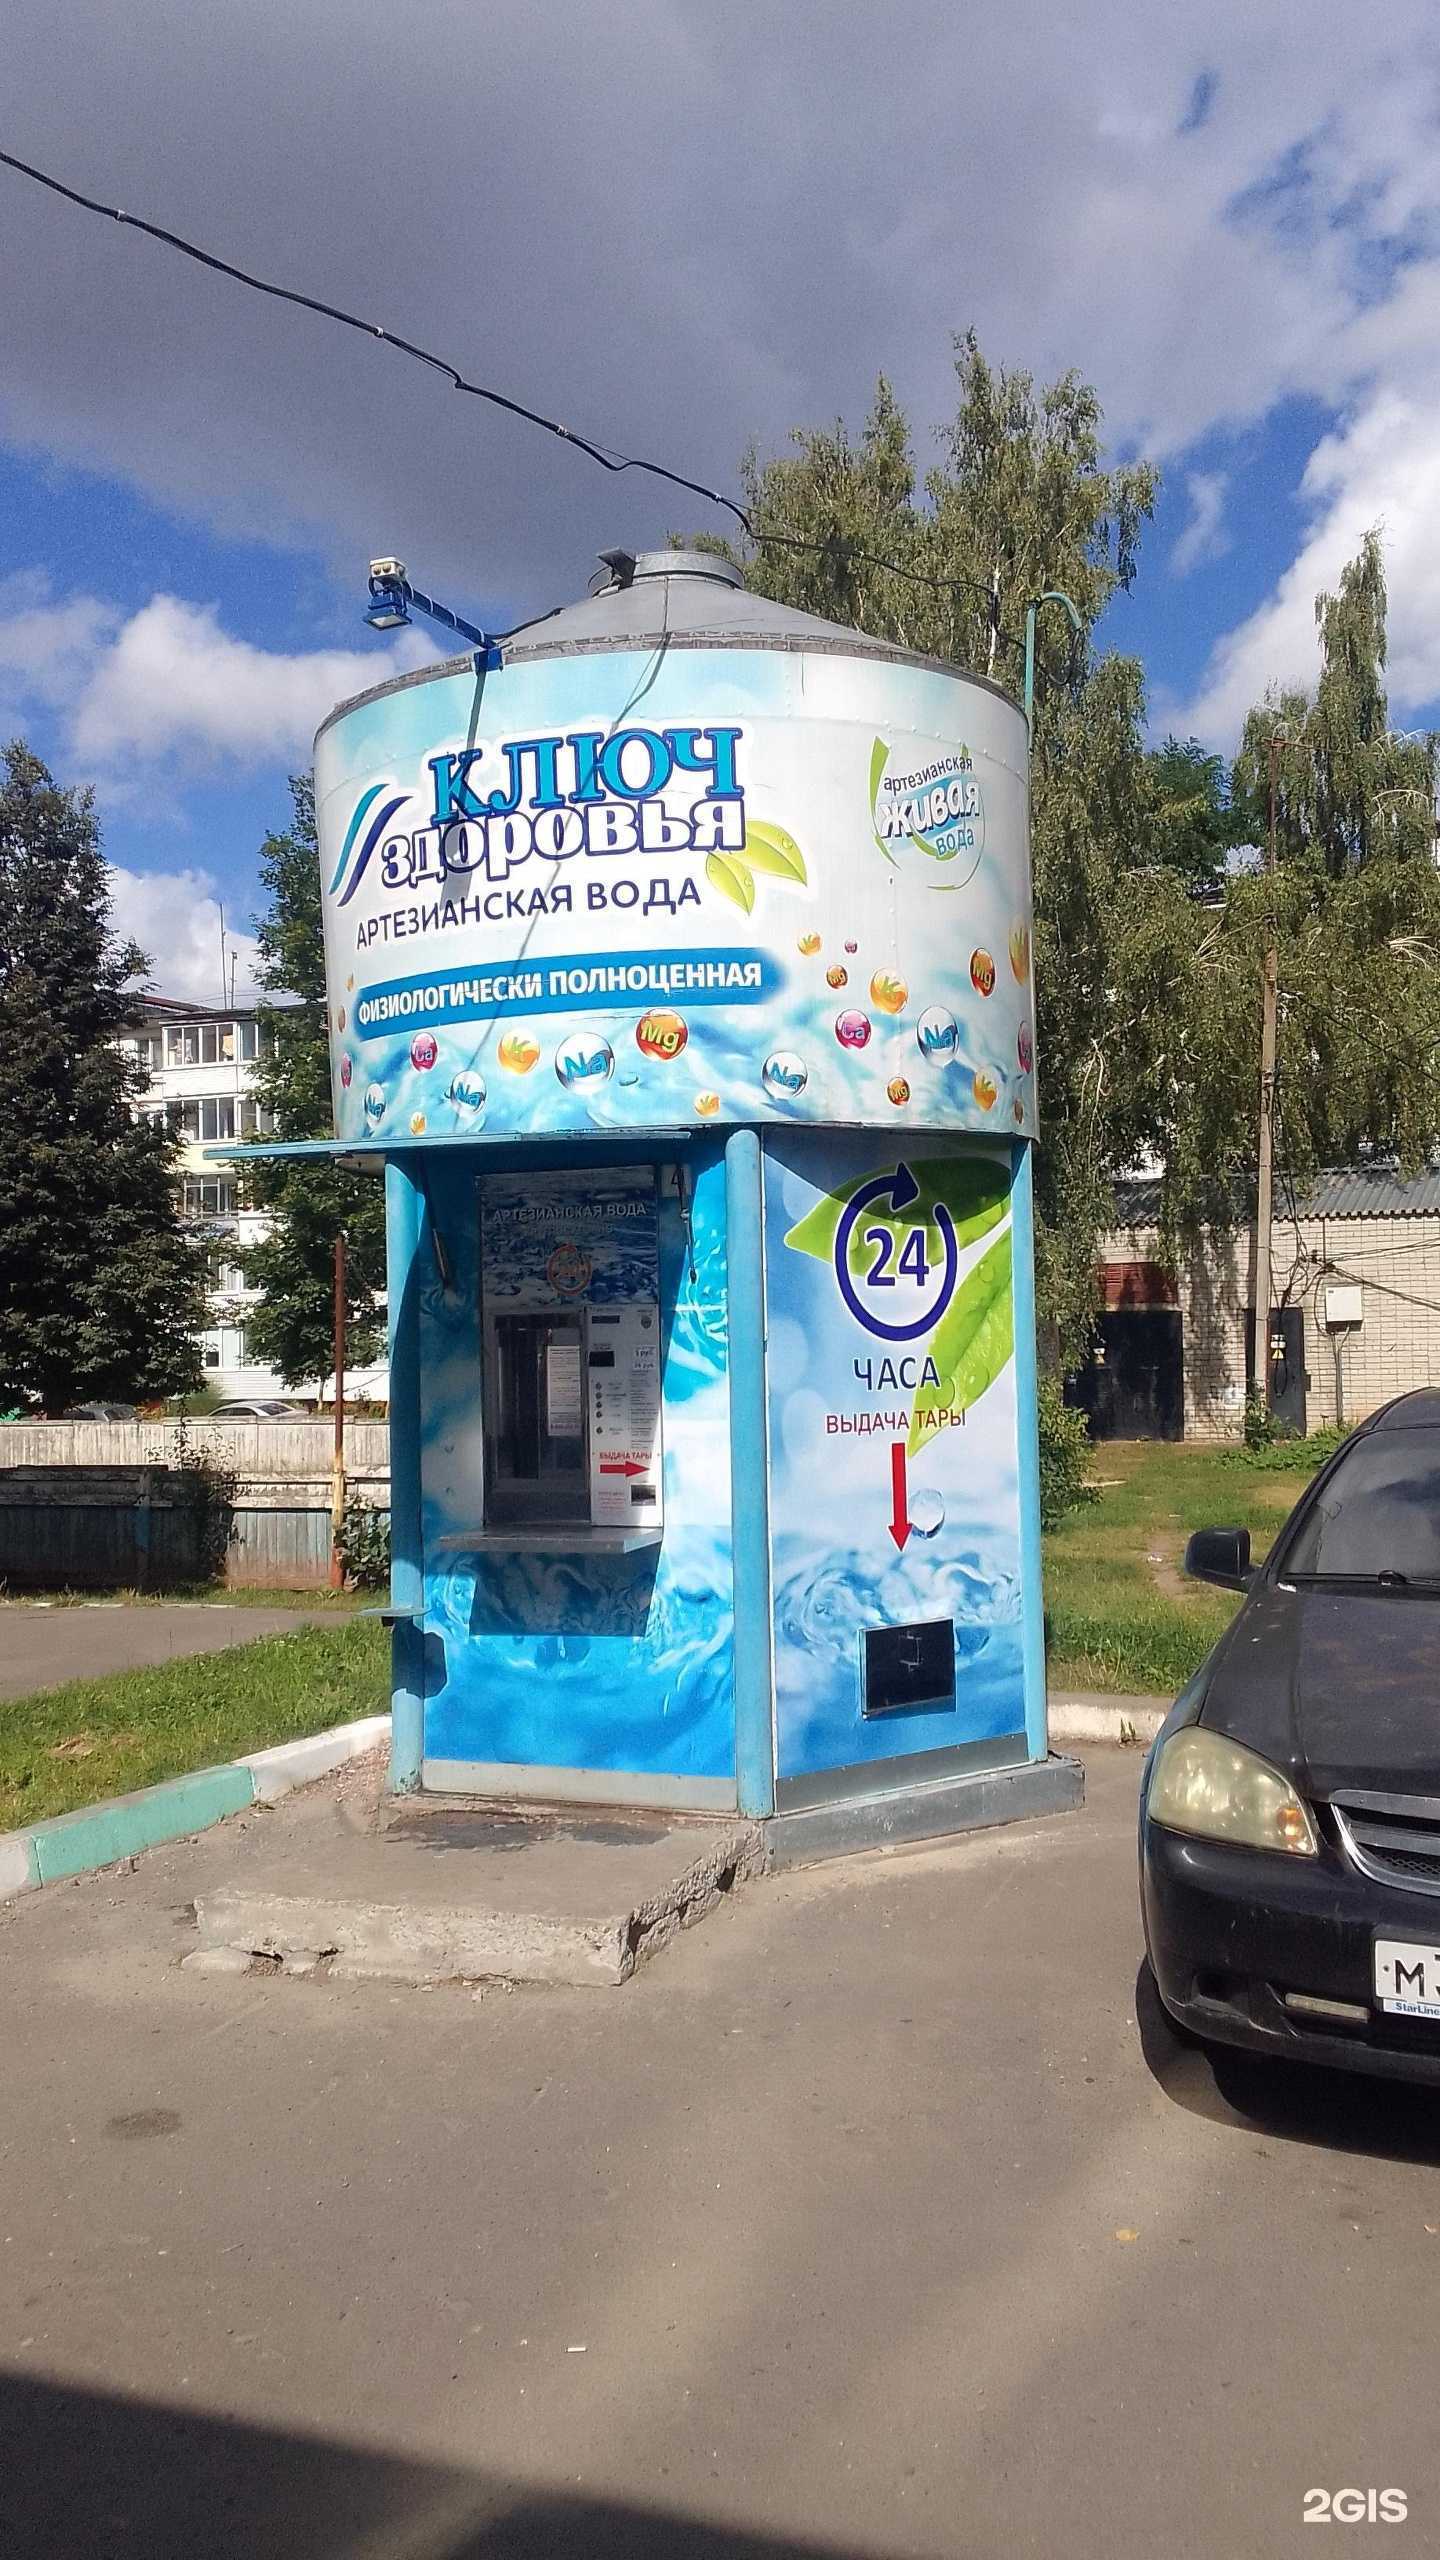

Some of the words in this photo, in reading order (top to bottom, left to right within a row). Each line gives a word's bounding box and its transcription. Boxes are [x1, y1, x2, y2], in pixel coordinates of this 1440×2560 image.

[428, 728, 744, 826] КЛЮЧ
[884, 756, 973, 796] артезианская
[935, 827, 975, 855] вода
[356, 884, 572, 950] АРТЕЗИАНСКАЯ
[587, 878, 702, 916] ВОДА
[973, 961, 992, 989] Mg
[358, 972, 543, 1025] ФИЗИОЛОГИЧЕСКИ
[549, 962, 762, 995] ПОЛНОЦЕННАЯ
[640, 1020, 680, 1053] Mg
[841, 1023, 865, 1039] Ca
[924, 1024, 958, 1050] Na
[563, 1050, 609, 1081] Na
[770, 1062, 805, 1091] Na
[455, 1082, 480, 1111] Na
[493, 1205, 602, 1224] АРТЕЗИАНСКАЯ
[607, 1203, 647, 1218] ВОДА
[866, 1228, 930, 1287] 24
[853, 1356, 941, 1391] ЧАСА
[826, 1411, 910, 1436] ВЫДАЧА
[915, 1408, 967, 1428] ТАРЫ
